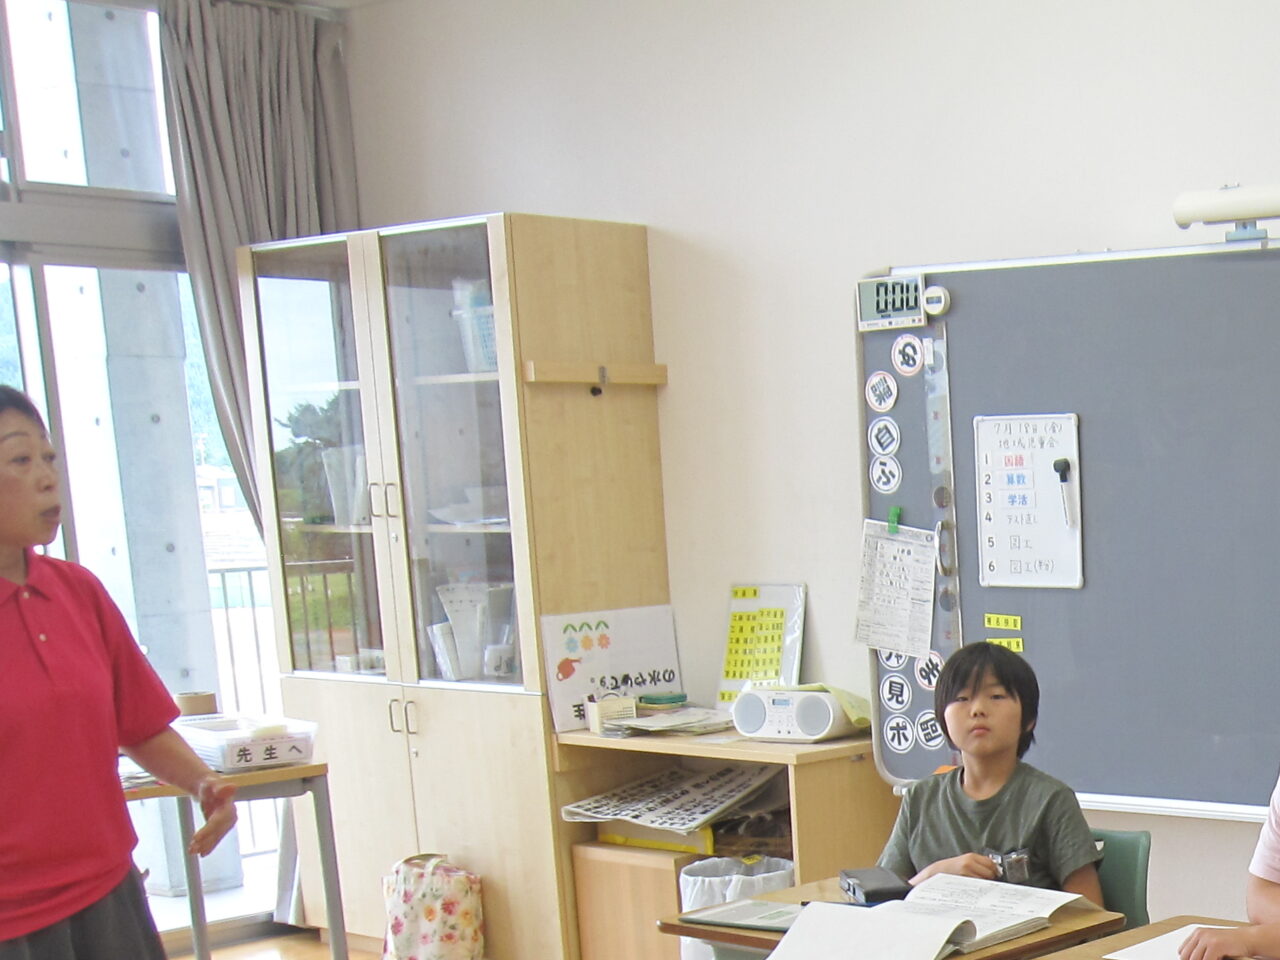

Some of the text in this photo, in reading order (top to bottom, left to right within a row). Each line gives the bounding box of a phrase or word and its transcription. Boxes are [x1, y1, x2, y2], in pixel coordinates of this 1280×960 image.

[984, 474, 991, 485] 2
[986, 492, 992, 504] 3
[985, 511, 993, 523] 4
[987, 536, 995, 548] 5
[988, 561, 995, 572] 6
[887, 680, 905, 705] 見
